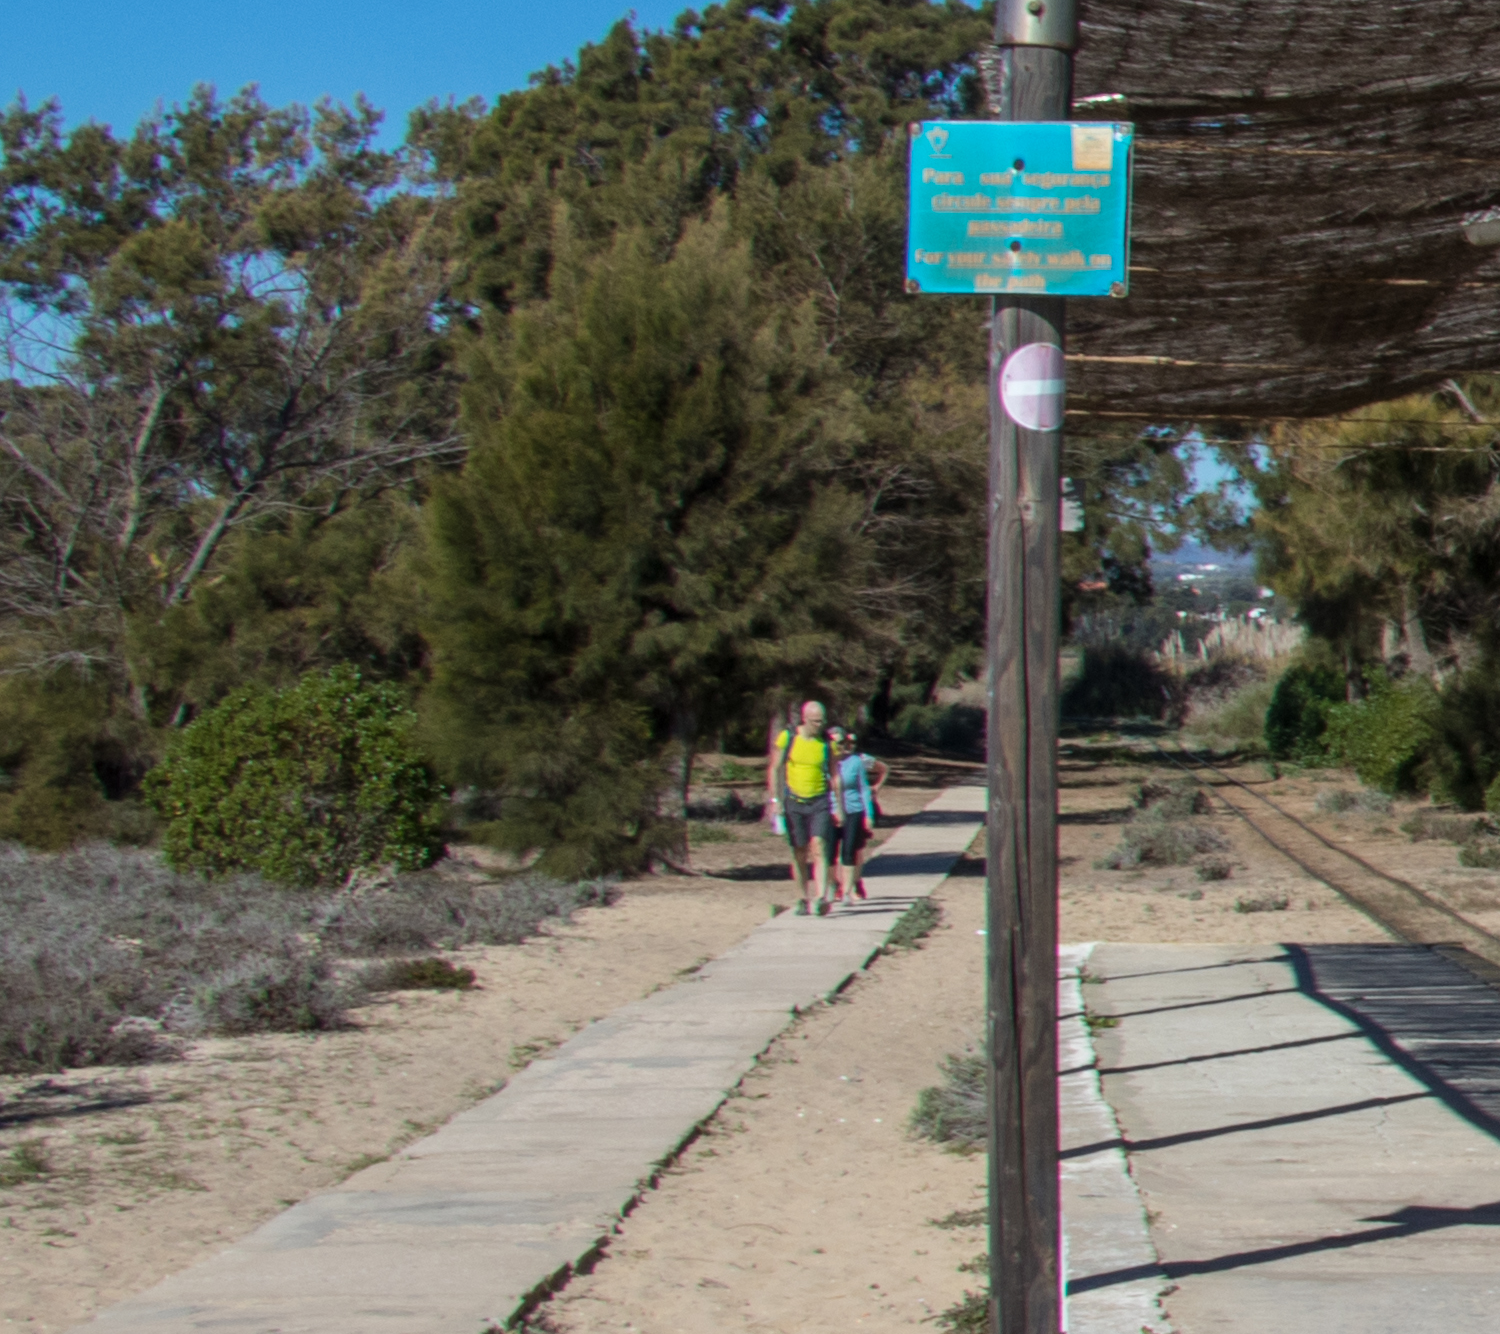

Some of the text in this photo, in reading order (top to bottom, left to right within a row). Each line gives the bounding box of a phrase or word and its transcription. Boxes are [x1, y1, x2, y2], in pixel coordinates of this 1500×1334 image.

[922, 167, 964, 185] Para
[1063, 195, 1101, 213] pela
[914, 248, 944, 265] For
